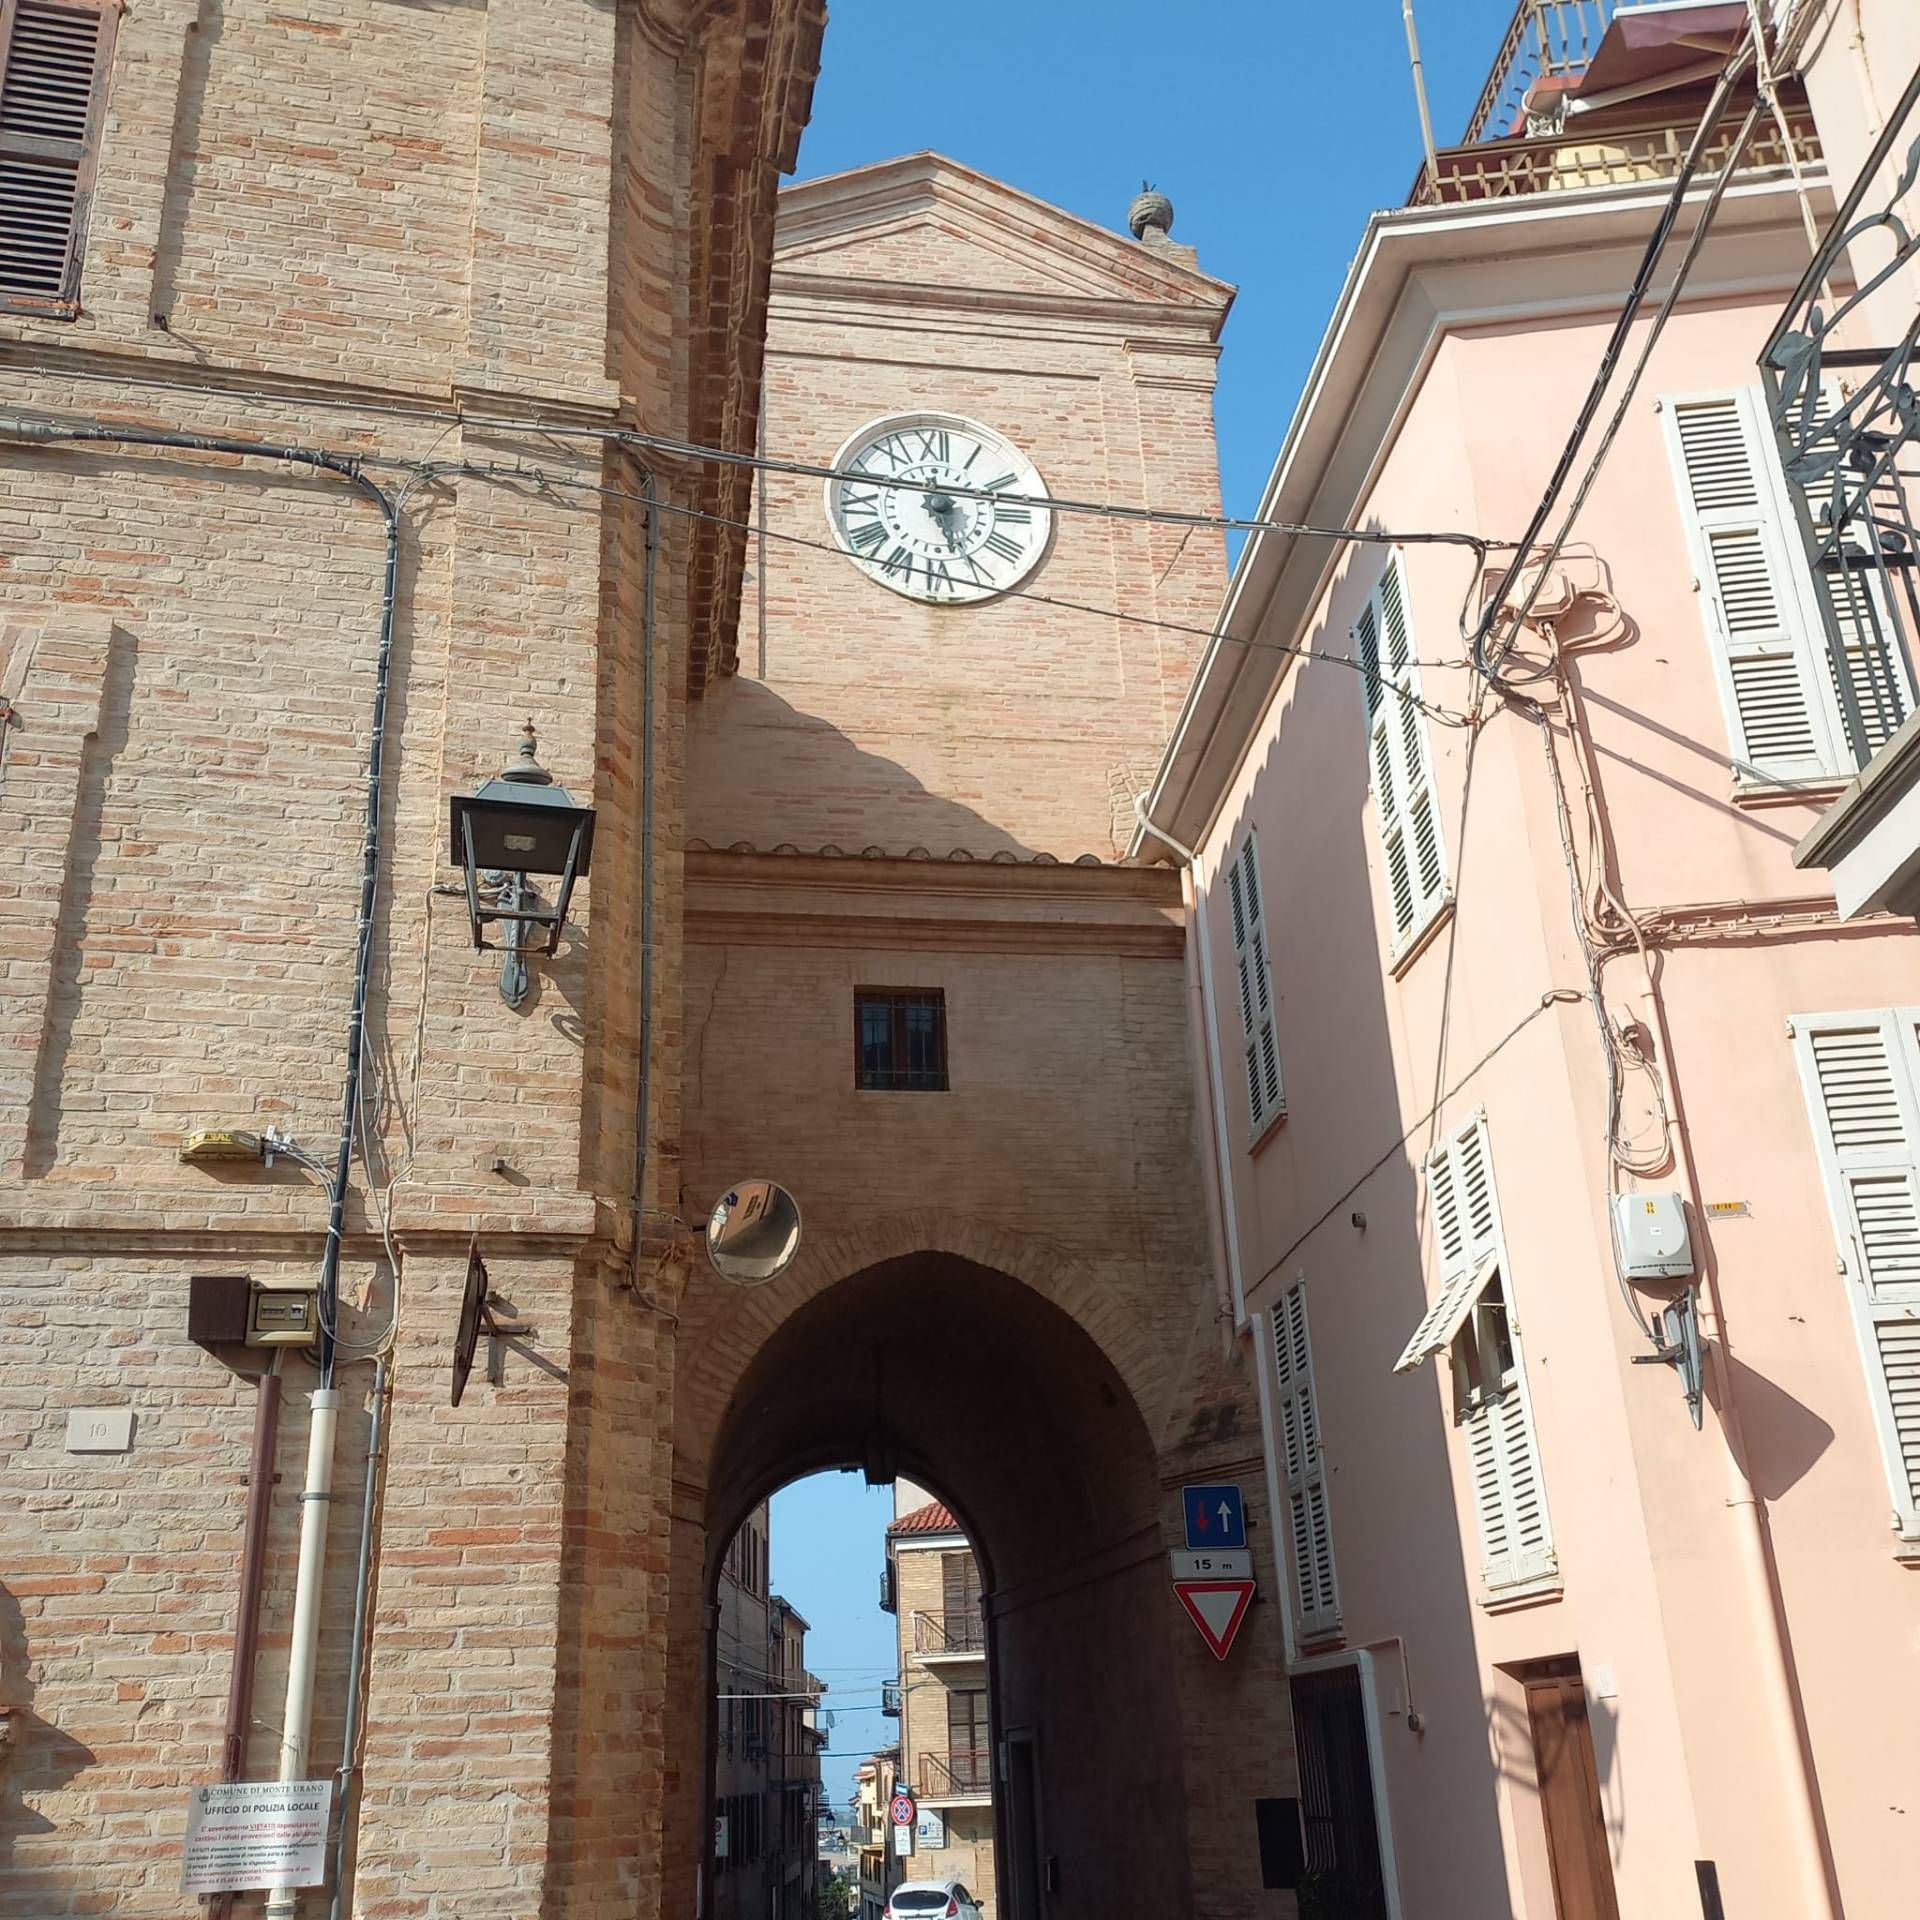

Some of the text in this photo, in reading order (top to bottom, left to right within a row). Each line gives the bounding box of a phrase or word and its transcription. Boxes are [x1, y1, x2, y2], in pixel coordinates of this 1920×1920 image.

[871, 433, 914, 472] XI
[915, 430, 950, 463] XII
[984, 472, 1019, 491] II
[840, 488, 879, 516] IX
[994, 508, 1032, 524] III
[89, 1423, 107, 1437] 10
[1193, 1559, 1212, 1571] 15
[211, 1784, 324, 1796] COMUNE DI MONTE URANO
[204, 1802, 320, 1815] UFFICIO DI POLIZIA LOCALE
[250, 1823, 277, 1831] VIETATO
[277, 1822, 309, 1831] depositare
